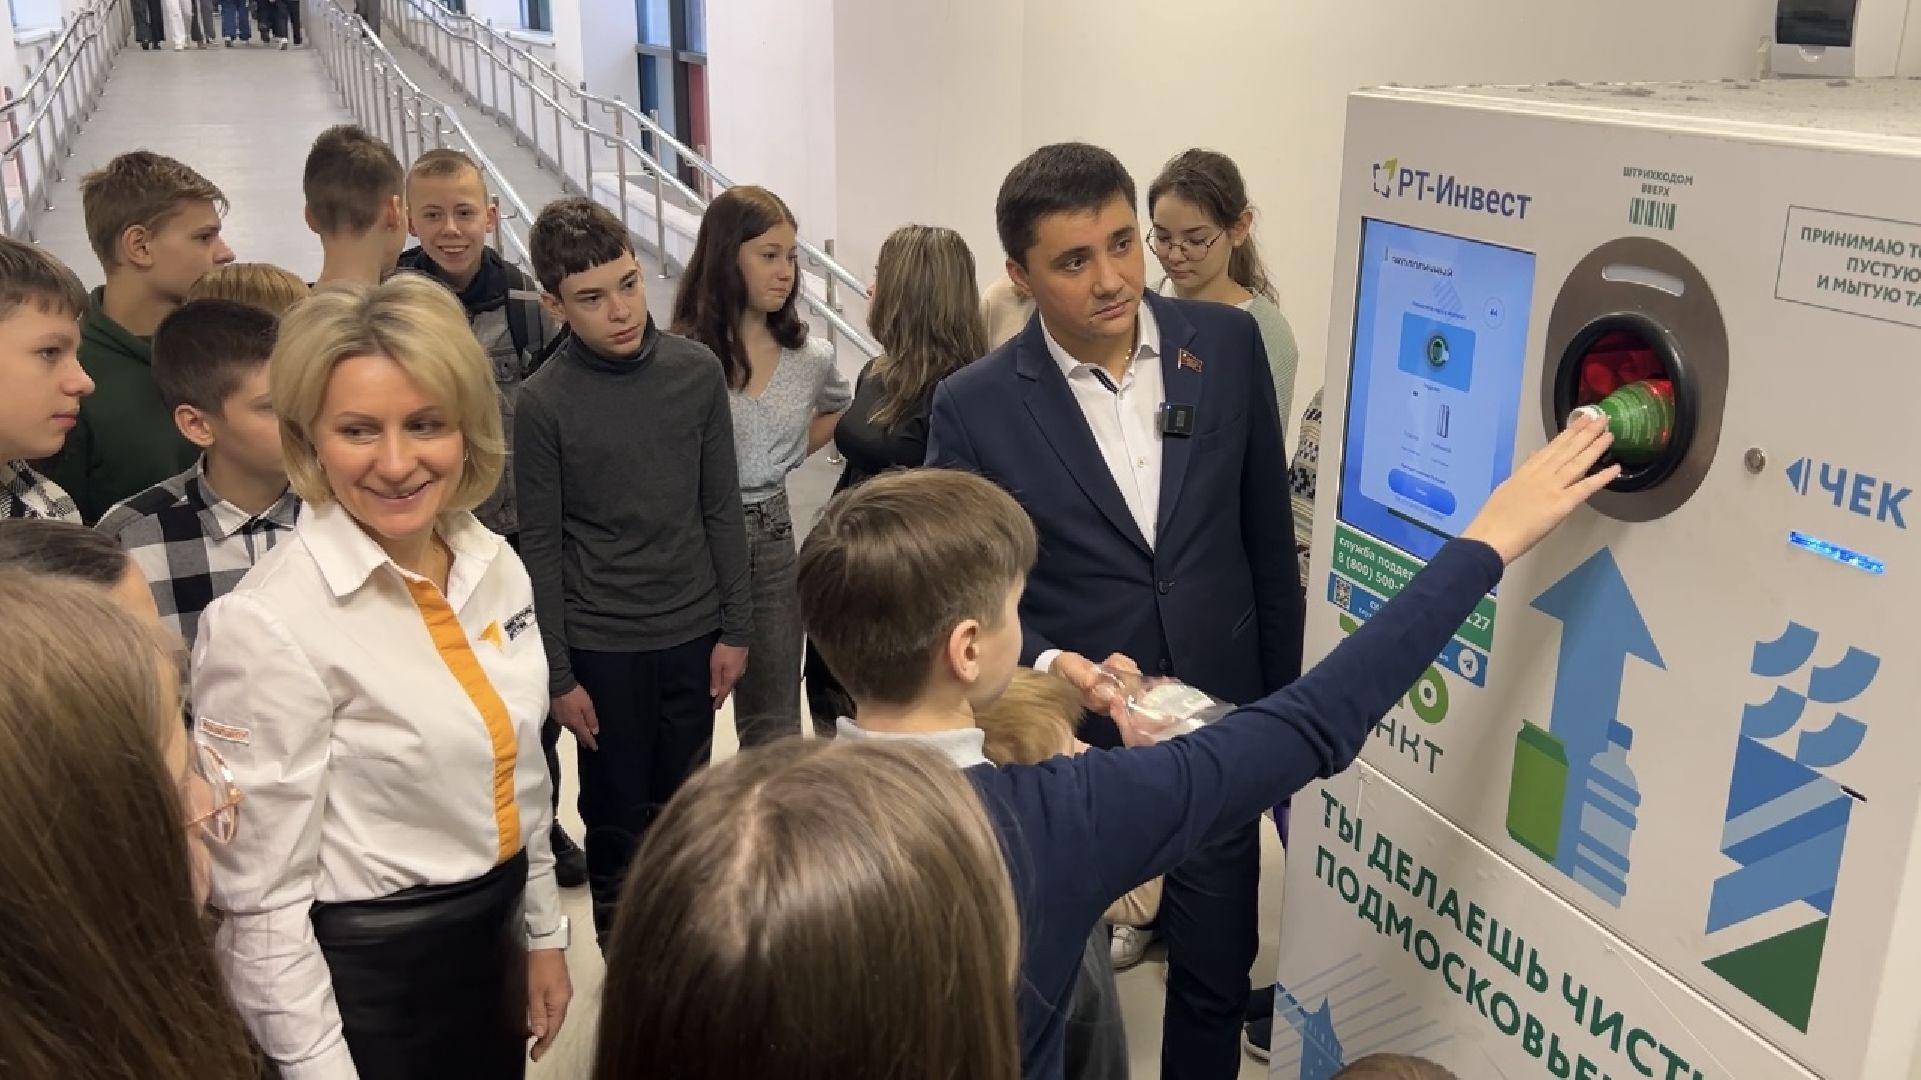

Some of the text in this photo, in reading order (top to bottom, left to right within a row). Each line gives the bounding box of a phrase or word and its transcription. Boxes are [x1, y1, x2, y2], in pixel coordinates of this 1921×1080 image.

[1398, 168, 1533, 220] РТ-Инвест
[1623, 166, 1694, 186] ШТРИХКОДОМ
[1641, 183, 1670, 197] ВВЕРХ
[1800, 226, 1921, 259] ПРИНИМАЮ Т
[1846, 256, 1921, 283] ПУСТУЮ
[1816, 275, 1830, 291] И
[1833, 277, 1902, 303] МЫТУЮ
[1819, 462, 1913, 529] ЧЕК
[1339, 537, 1415, 581] служба поддер
[1321, 788, 1704, 1080] ТЫ ДЕЛАЕШЬ ЧИСТ
[1315, 844, 1613, 1080] ПОДМОСКОВЬЕ
